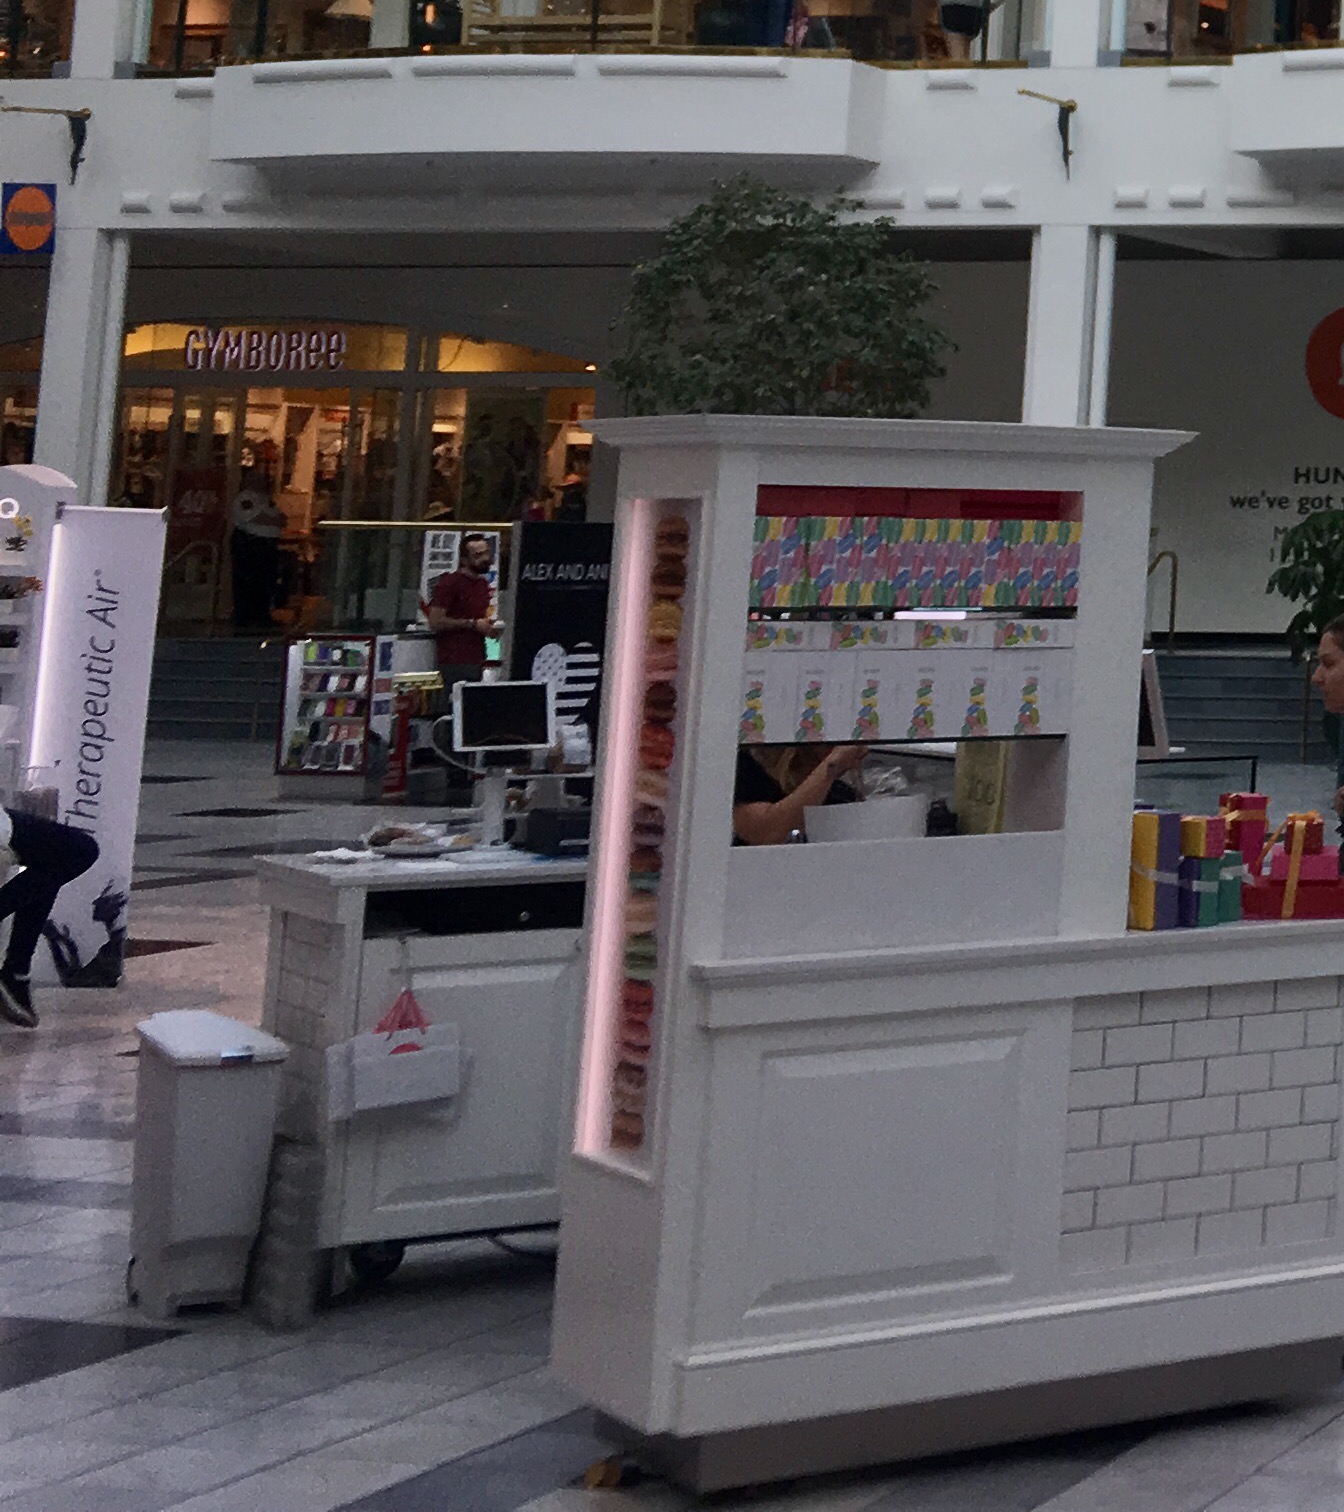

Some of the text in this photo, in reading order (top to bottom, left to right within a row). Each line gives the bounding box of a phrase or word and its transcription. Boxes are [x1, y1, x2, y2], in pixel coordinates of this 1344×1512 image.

[1229, 489, 1290, 510] we've
[1297, 493, 1334, 514] got
[556, 563, 585, 581] AND
[64, 635, 115, 834] Therapeutic
